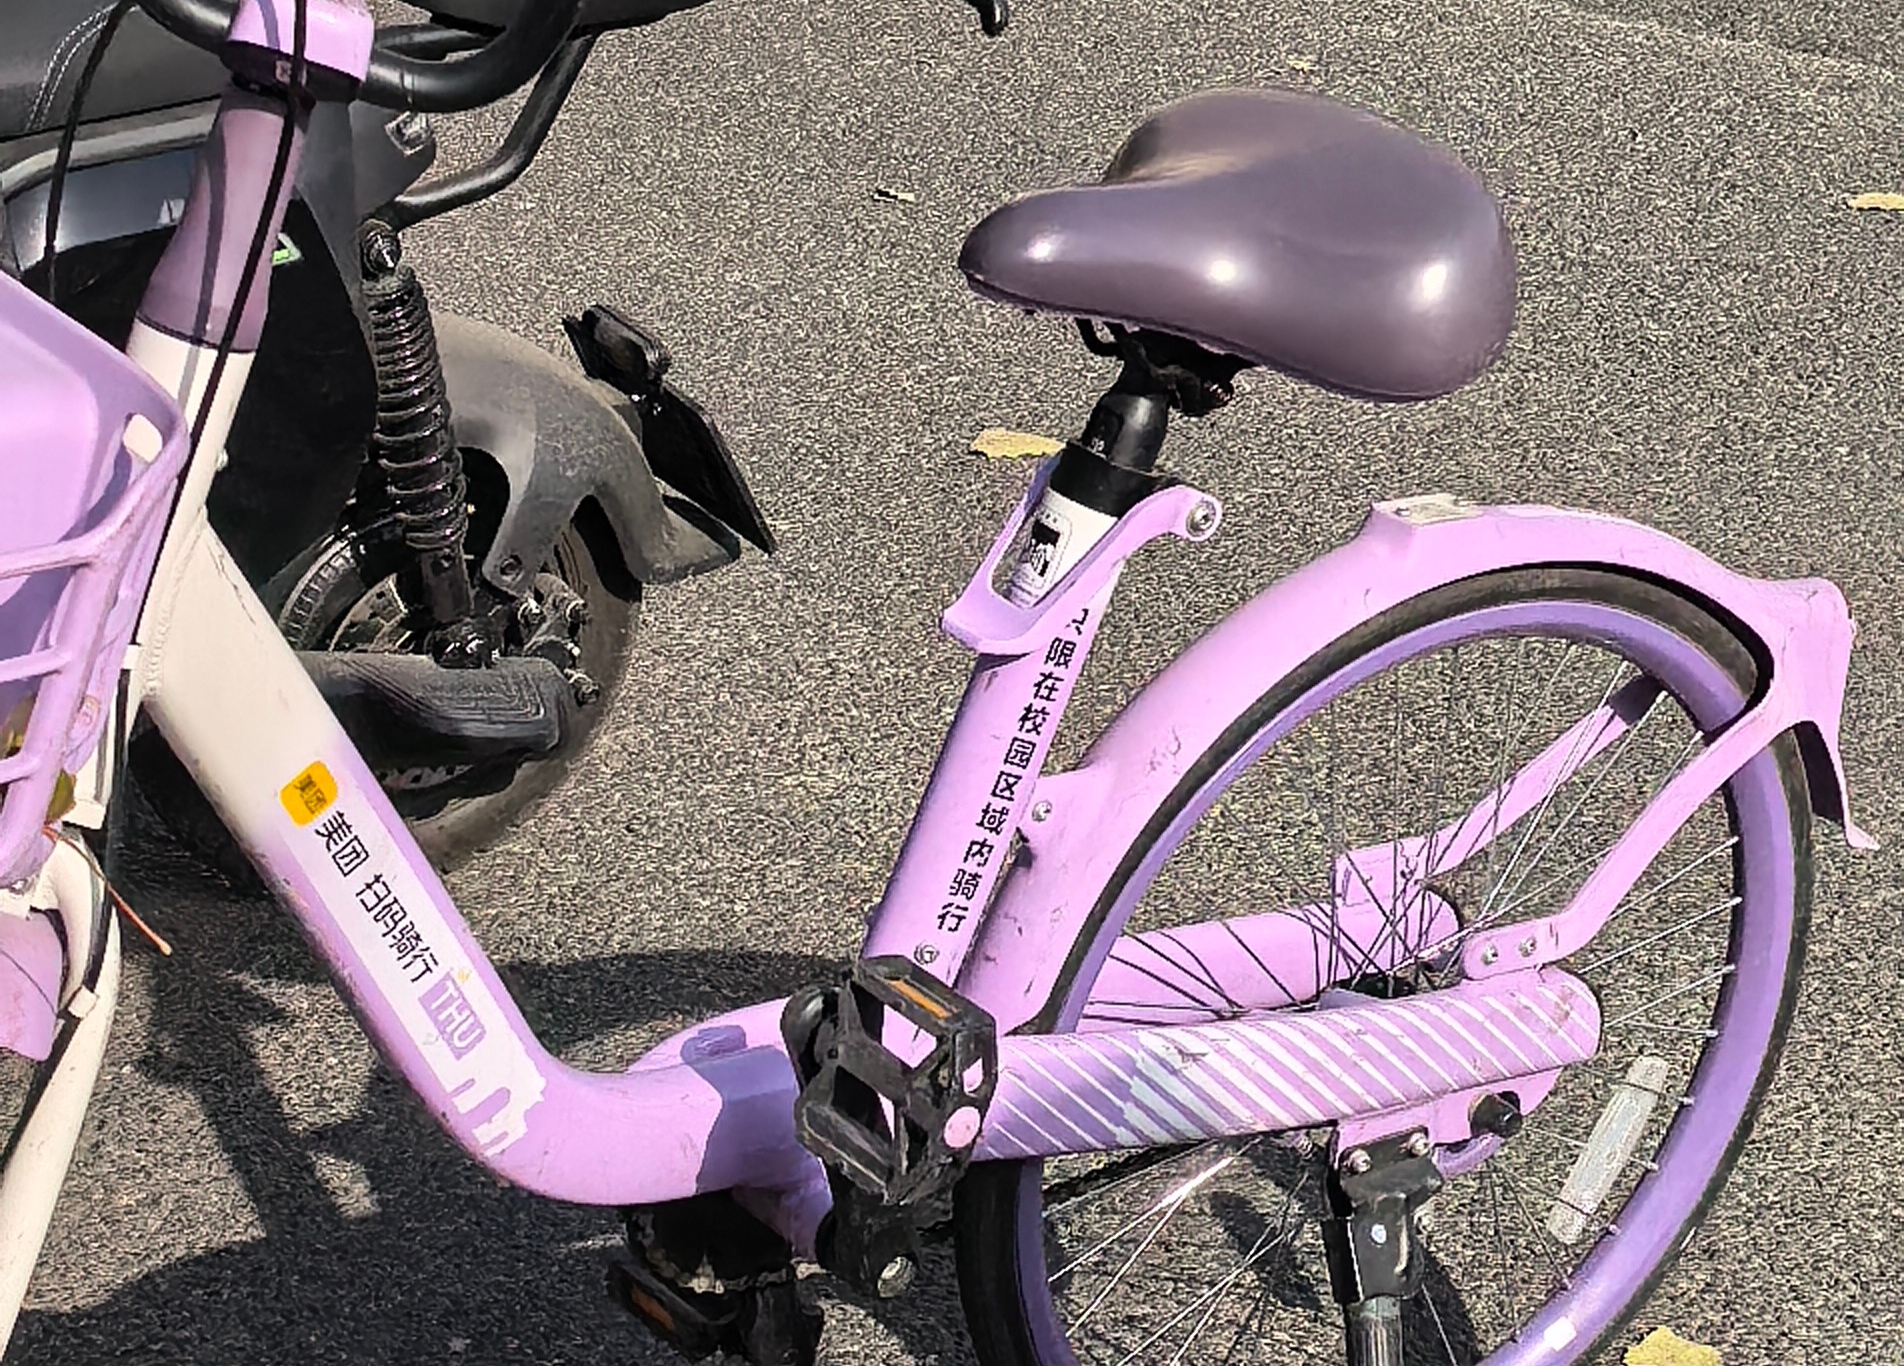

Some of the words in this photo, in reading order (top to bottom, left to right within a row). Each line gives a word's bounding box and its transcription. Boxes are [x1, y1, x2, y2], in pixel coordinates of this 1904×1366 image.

[314, 810, 370, 877] 美团
[355, 874, 438, 982] 扫码骑行
[430, 980, 483, 1049] THU
